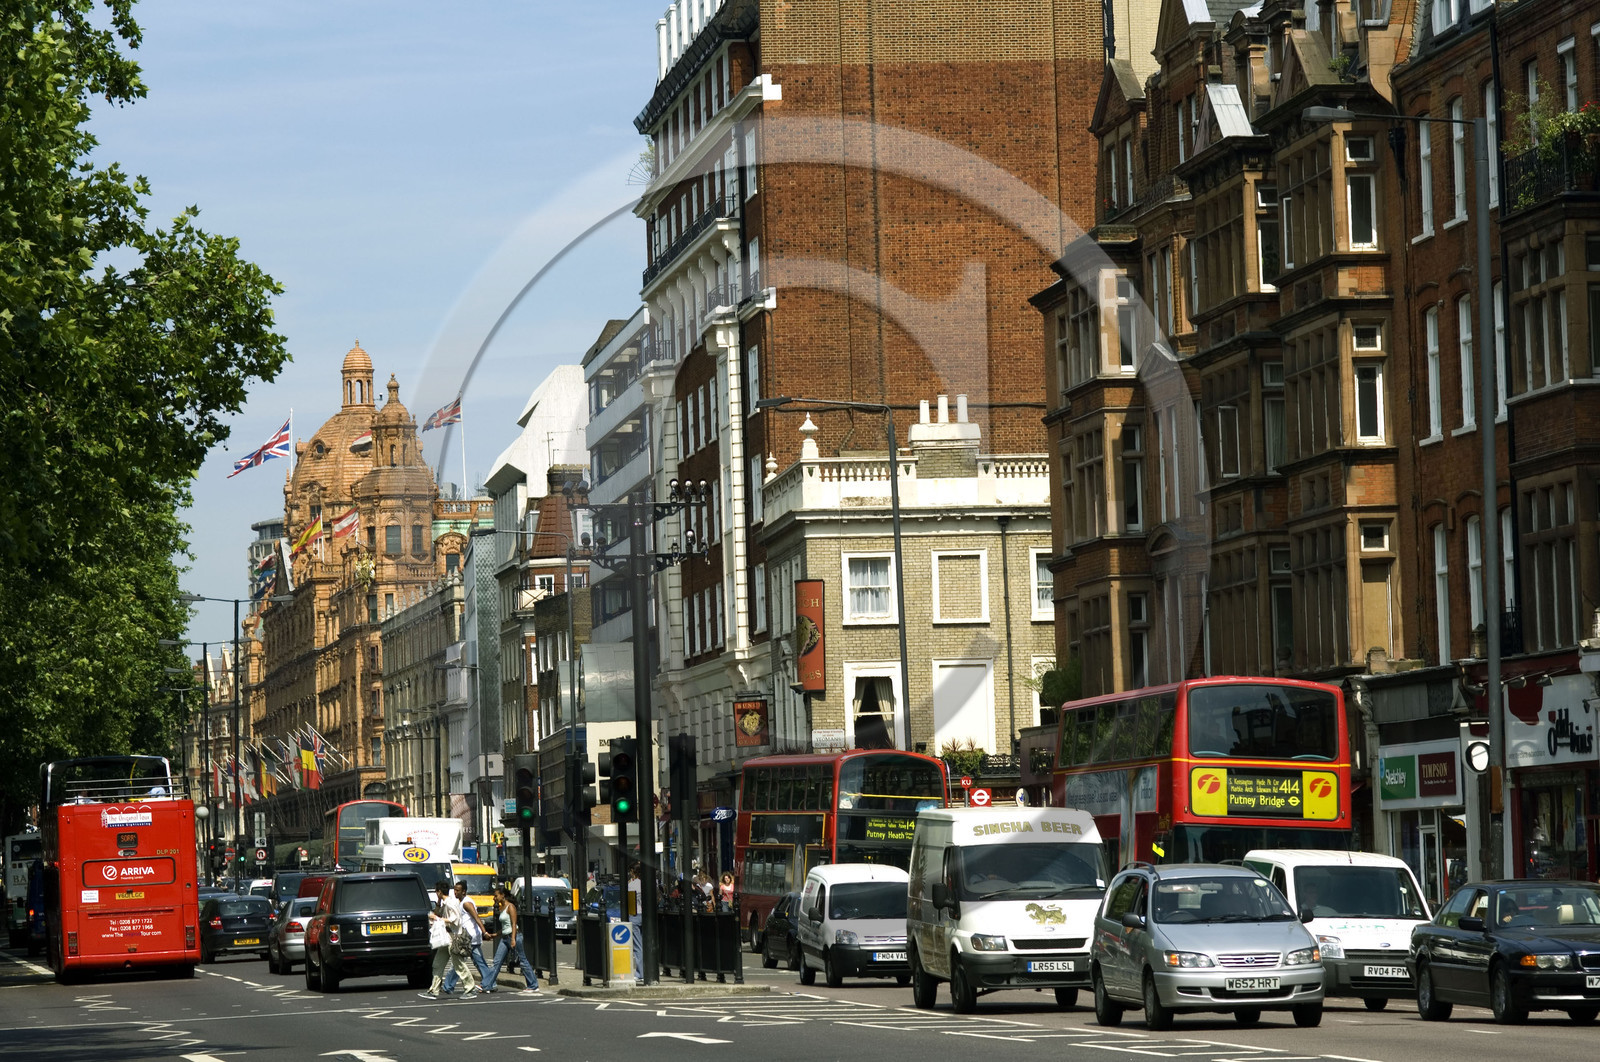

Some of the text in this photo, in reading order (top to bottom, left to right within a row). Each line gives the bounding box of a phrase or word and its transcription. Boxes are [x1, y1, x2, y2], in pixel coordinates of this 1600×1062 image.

[1422, 761, 1448, 778] TIMPSON
[1385, 767, 1406, 788] Sketchley
[1279, 779, 1300, 794] 414
[1229, 794, 1286, 808] Putney Bridge
[906, 819, 915, 830] 14
[973, 821, 1082, 836] SINGHA BEER
[866, 829, 886, 840] Putney
[887, 830, 905, 839] Heath
[120, 866, 155, 876] ARRIVA
[1033, 962, 1072, 971] LR55 LSL
[1367, 967, 1408, 976] RV04 FPN
[1227, 978, 1278, 989] W652 HRT
[1587, 976, 1600, 987] W7
